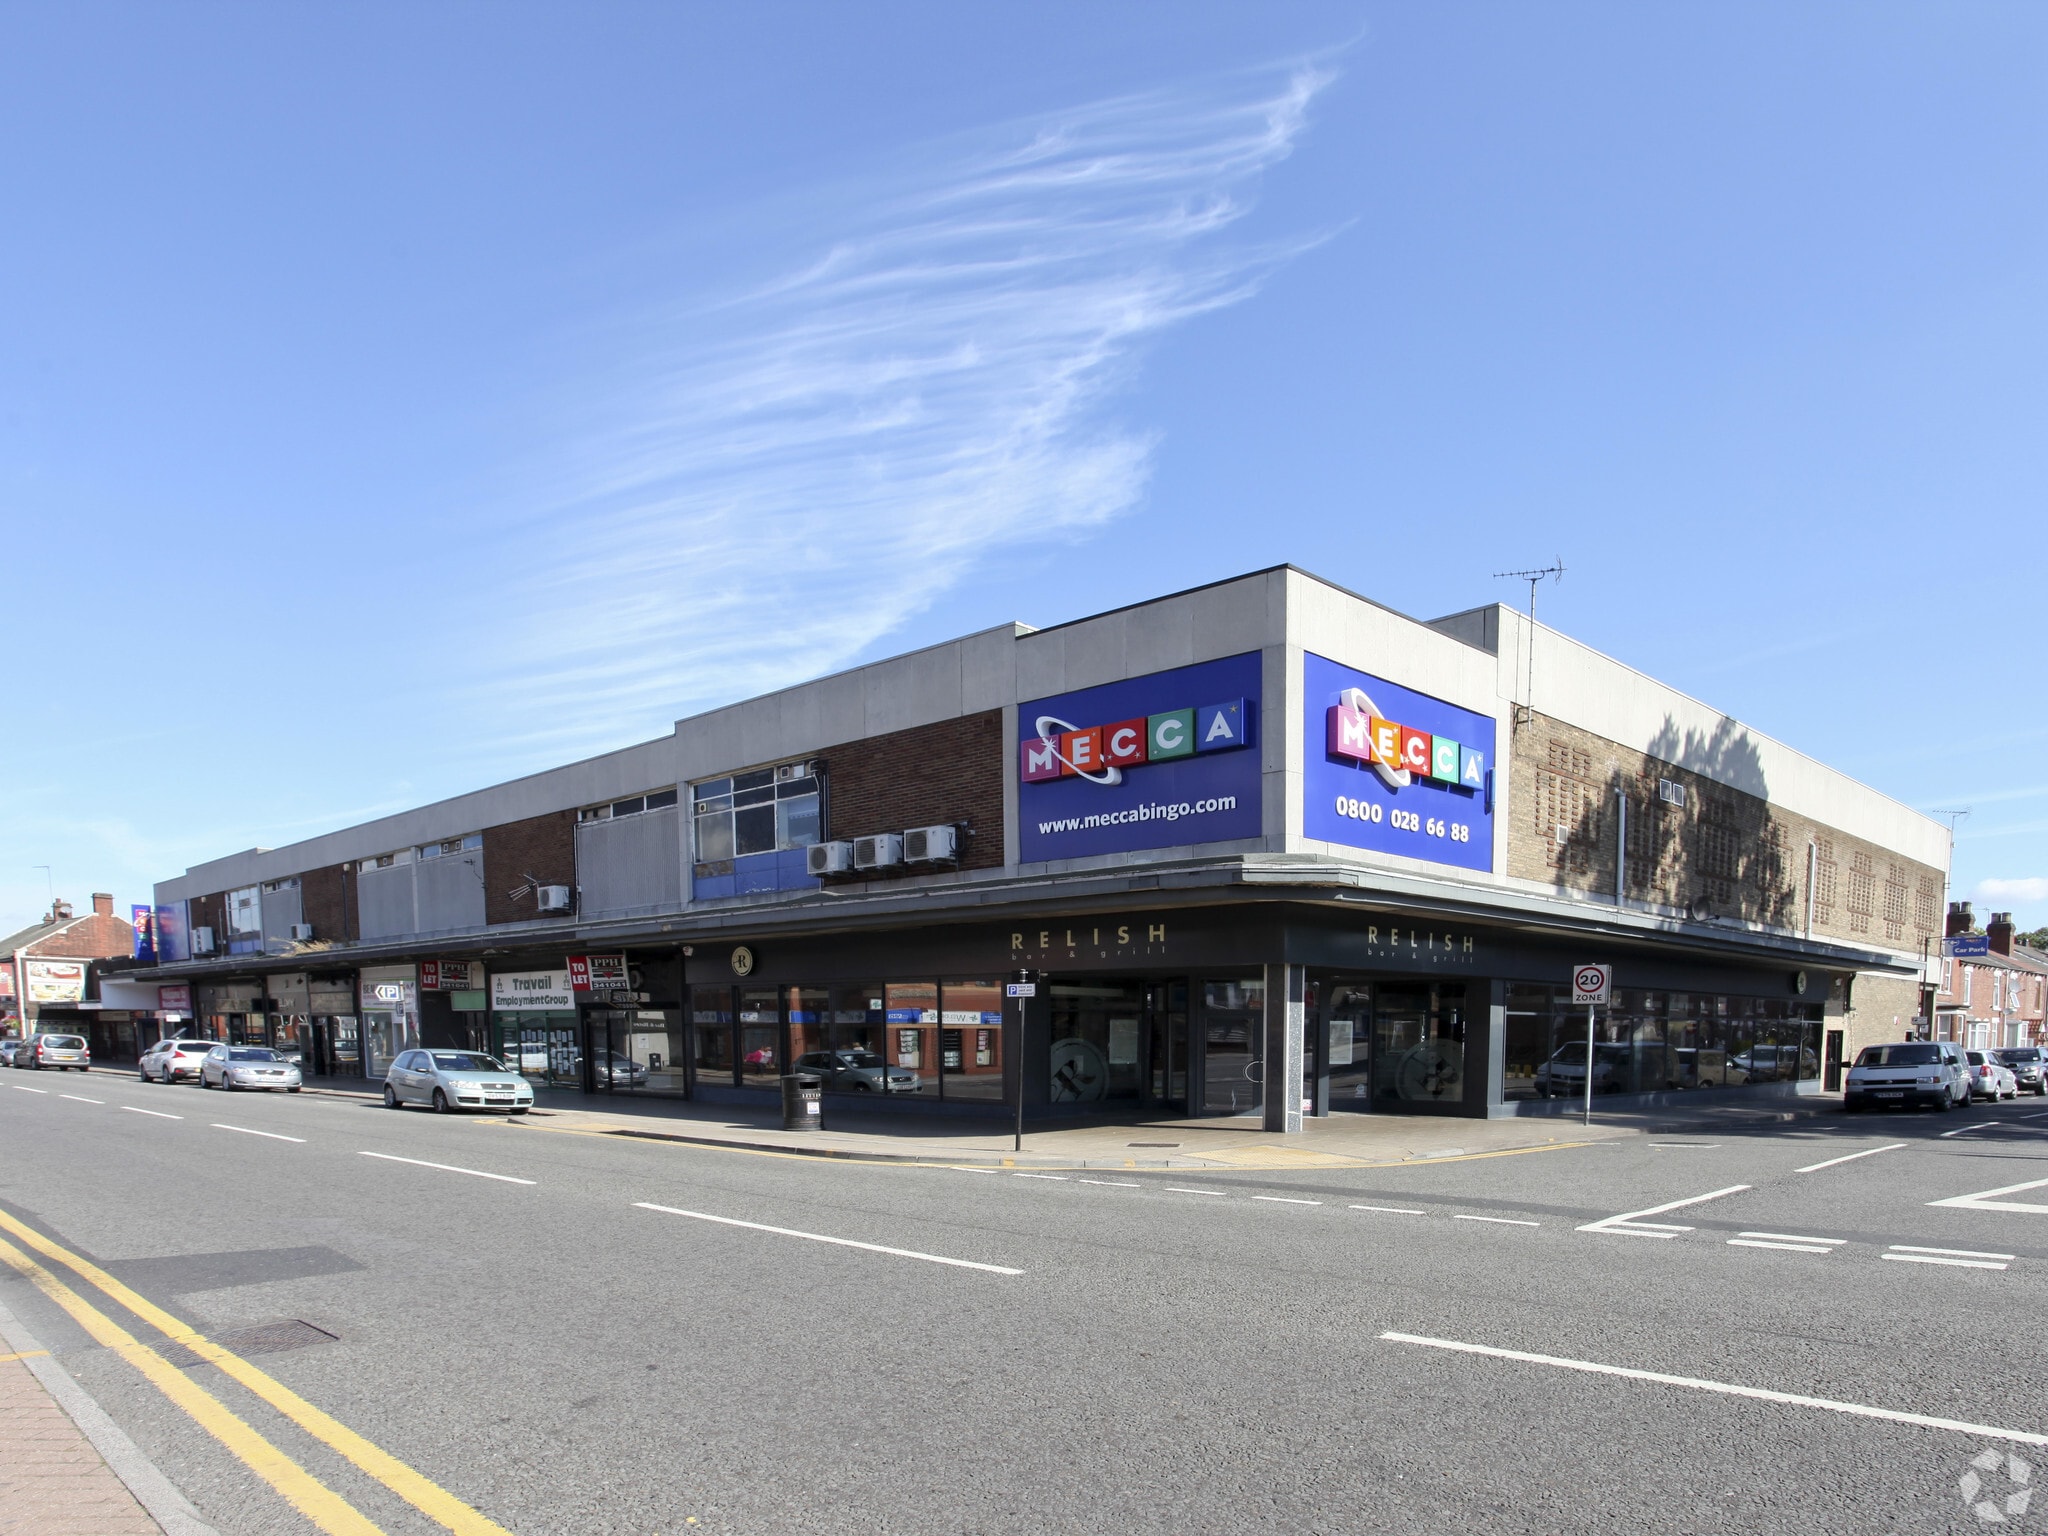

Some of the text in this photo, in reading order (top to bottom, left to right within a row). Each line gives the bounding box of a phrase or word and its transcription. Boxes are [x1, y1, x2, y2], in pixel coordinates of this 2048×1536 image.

[1028, 710, 1234, 774] MECCA
[1342, 715, 1481, 783] MECCA
[1038, 795, 1237, 835] www.meccabingo.com
[1336, 796, 1470, 843] 0800 028 66 88
[1011, 923, 1165, 950] RELISH
[1368, 926, 1473, 953] RELISH
[1011, 946, 1165, 961] bar & grill
[1367, 947, 1396, 957] bar
[1433, 955, 1473, 964] grill
[424, 963, 436, 973] TO
[444, 963, 466, 971] PPH
[572, 963, 585, 972] TO
[594, 958, 619, 967] PPH
[423, 975, 437, 984] LET
[512, 975, 552, 991] Travail
[572, 975, 588, 984] LET
[1580, 974, 1600, 986] 20
